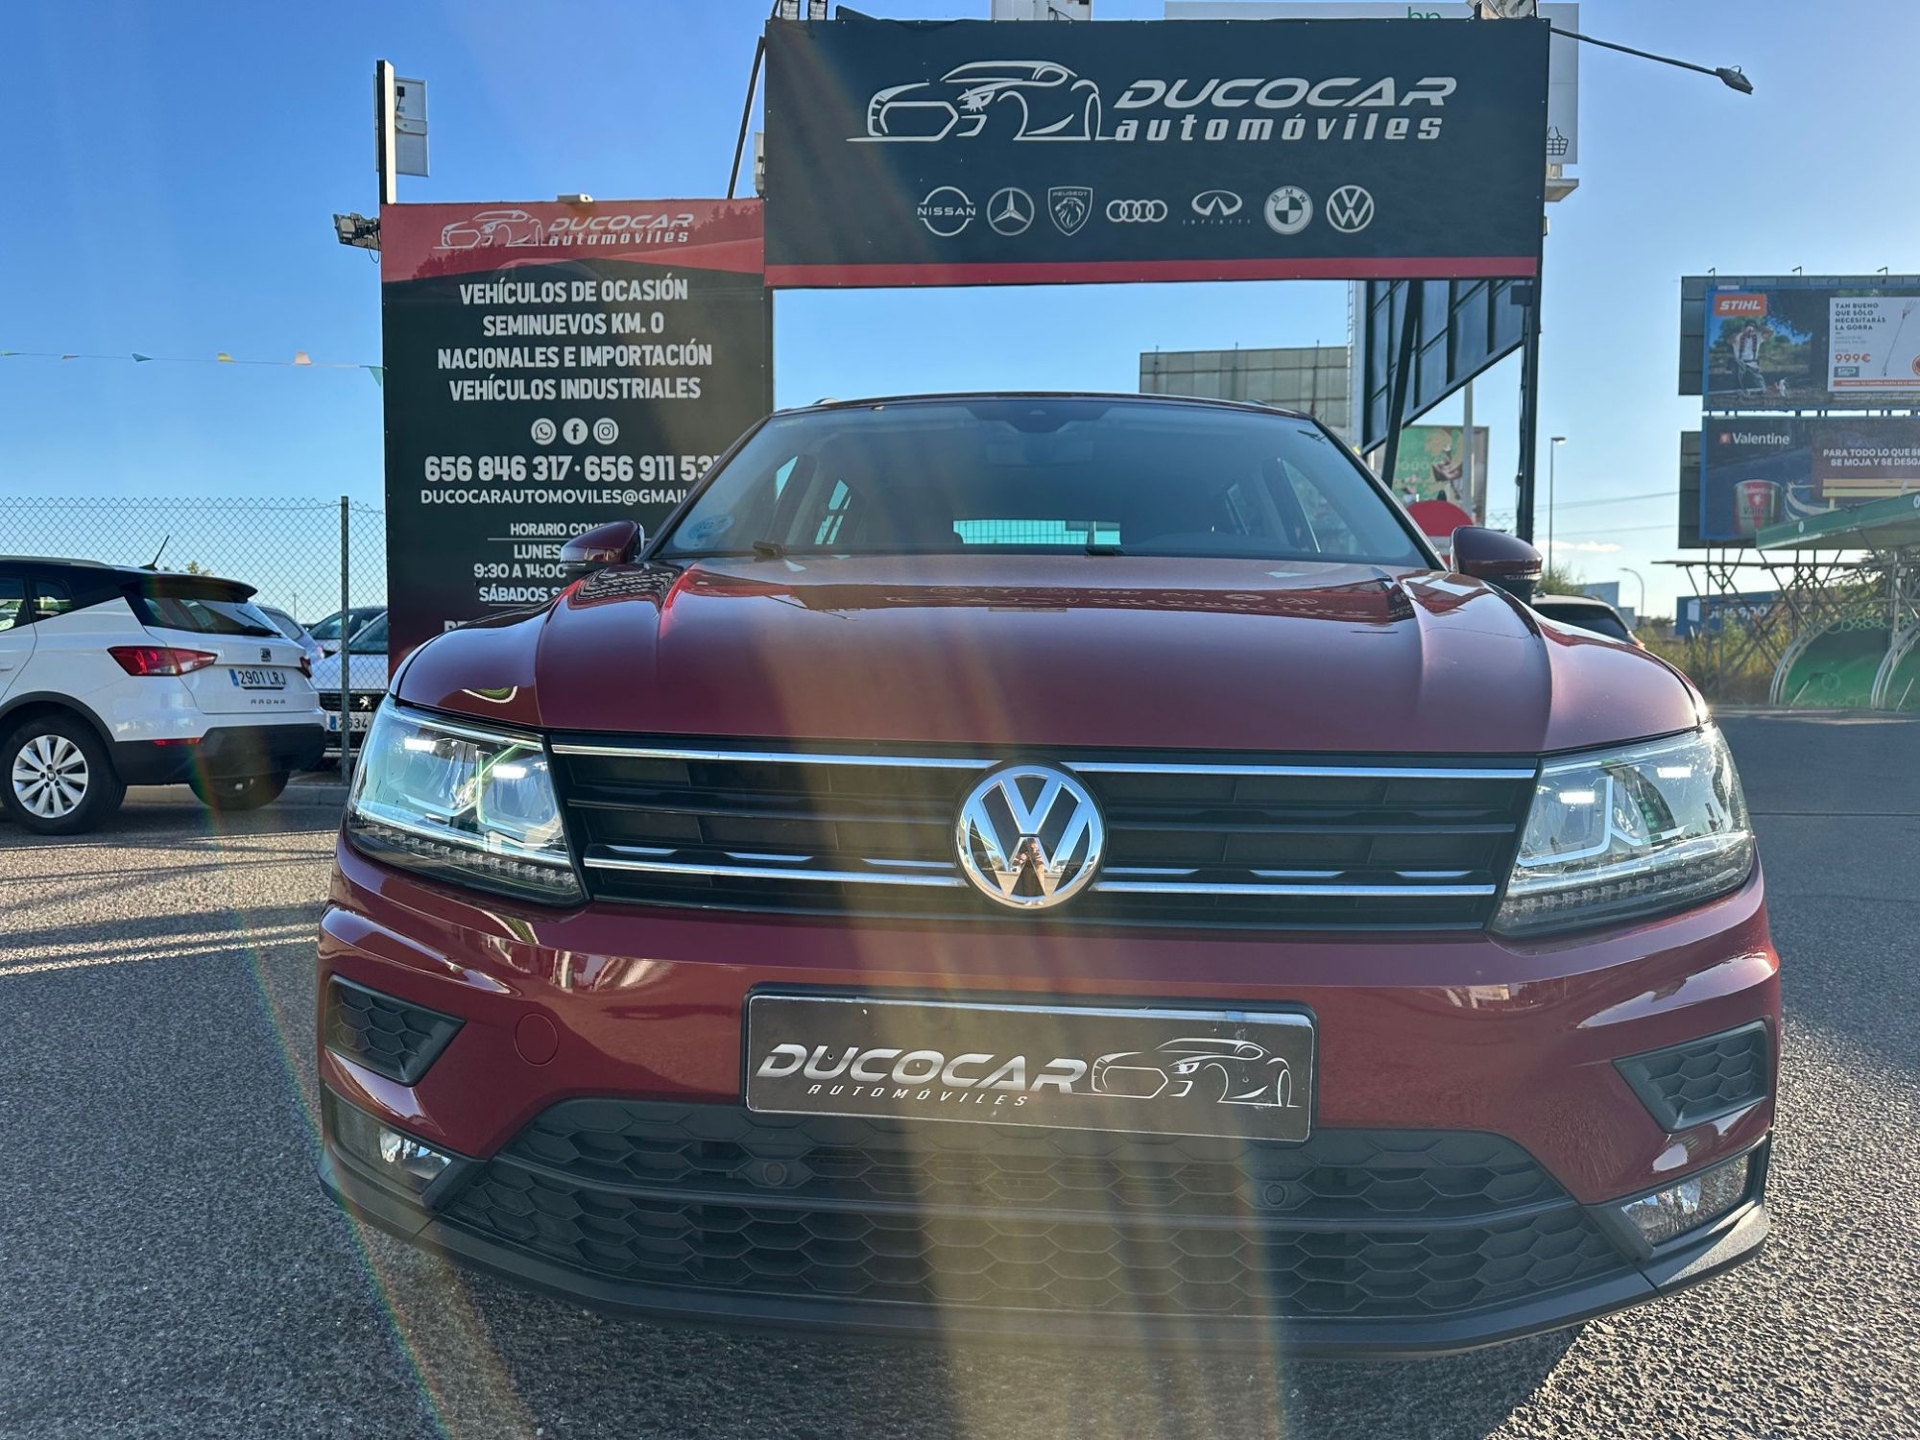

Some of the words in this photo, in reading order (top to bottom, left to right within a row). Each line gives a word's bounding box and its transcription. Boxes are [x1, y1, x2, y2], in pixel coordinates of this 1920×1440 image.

[1113, 76, 1457, 108] DUCOCAR
[1114, 113, 1443, 141] automóviles
[917, 207, 976, 216] NISSAN
[548, 213, 694, 232] DUCOCAR
[460, 278, 566, 304] VEHÍCULOS
[571, 281, 596, 302] DE
[601, 273, 688, 302] OCASIÓN
[1720, 299, 1761, 310] STIHL
[483, 313, 607, 337] SEMINUEVOS
[611, 313, 646, 334] KM.
[438, 346, 559, 369] NACIONALES
[564, 346, 576, 367] E
[580, 338, 712, 367] IMPORTACIÓN
[1835, 353, 1871, 363] 999€
[449, 374, 556, 401] VEHÍCULOS
[561, 377, 701, 400] INDUSTRIALES
[1732, 432, 1790, 445] Valentine
[1823, 448, 1848, 457] PARA
[1850, 448, 1876, 457] TODO
[1877, 448, 1889, 457] LO
[1891, 448, 1910, 457] QUE
[424, 455, 473, 482] 656
[478, 455, 527, 482] 846
[640, 455, 675, 482] 911
[681, 455, 720, 482] 53
[1831, 459, 1842, 467] SE
[1844, 459, 1871, 467] MOJA
[1881, 458, 1893, 466] SE
[510, 523, 567, 536] HORARIO
[514, 544, 561, 559] LUNES
[473, 563, 509, 578] 9:30
[512, 563, 522, 578] A
[479, 583, 548, 602] SÁBADOS
[238, 670, 266, 685] 2901
[266, 671, 286, 685] LRJ
[756, 1042, 1091, 1094] DUCOCAR
[806, 1082, 1030, 1107] AUTOMÓVILES
